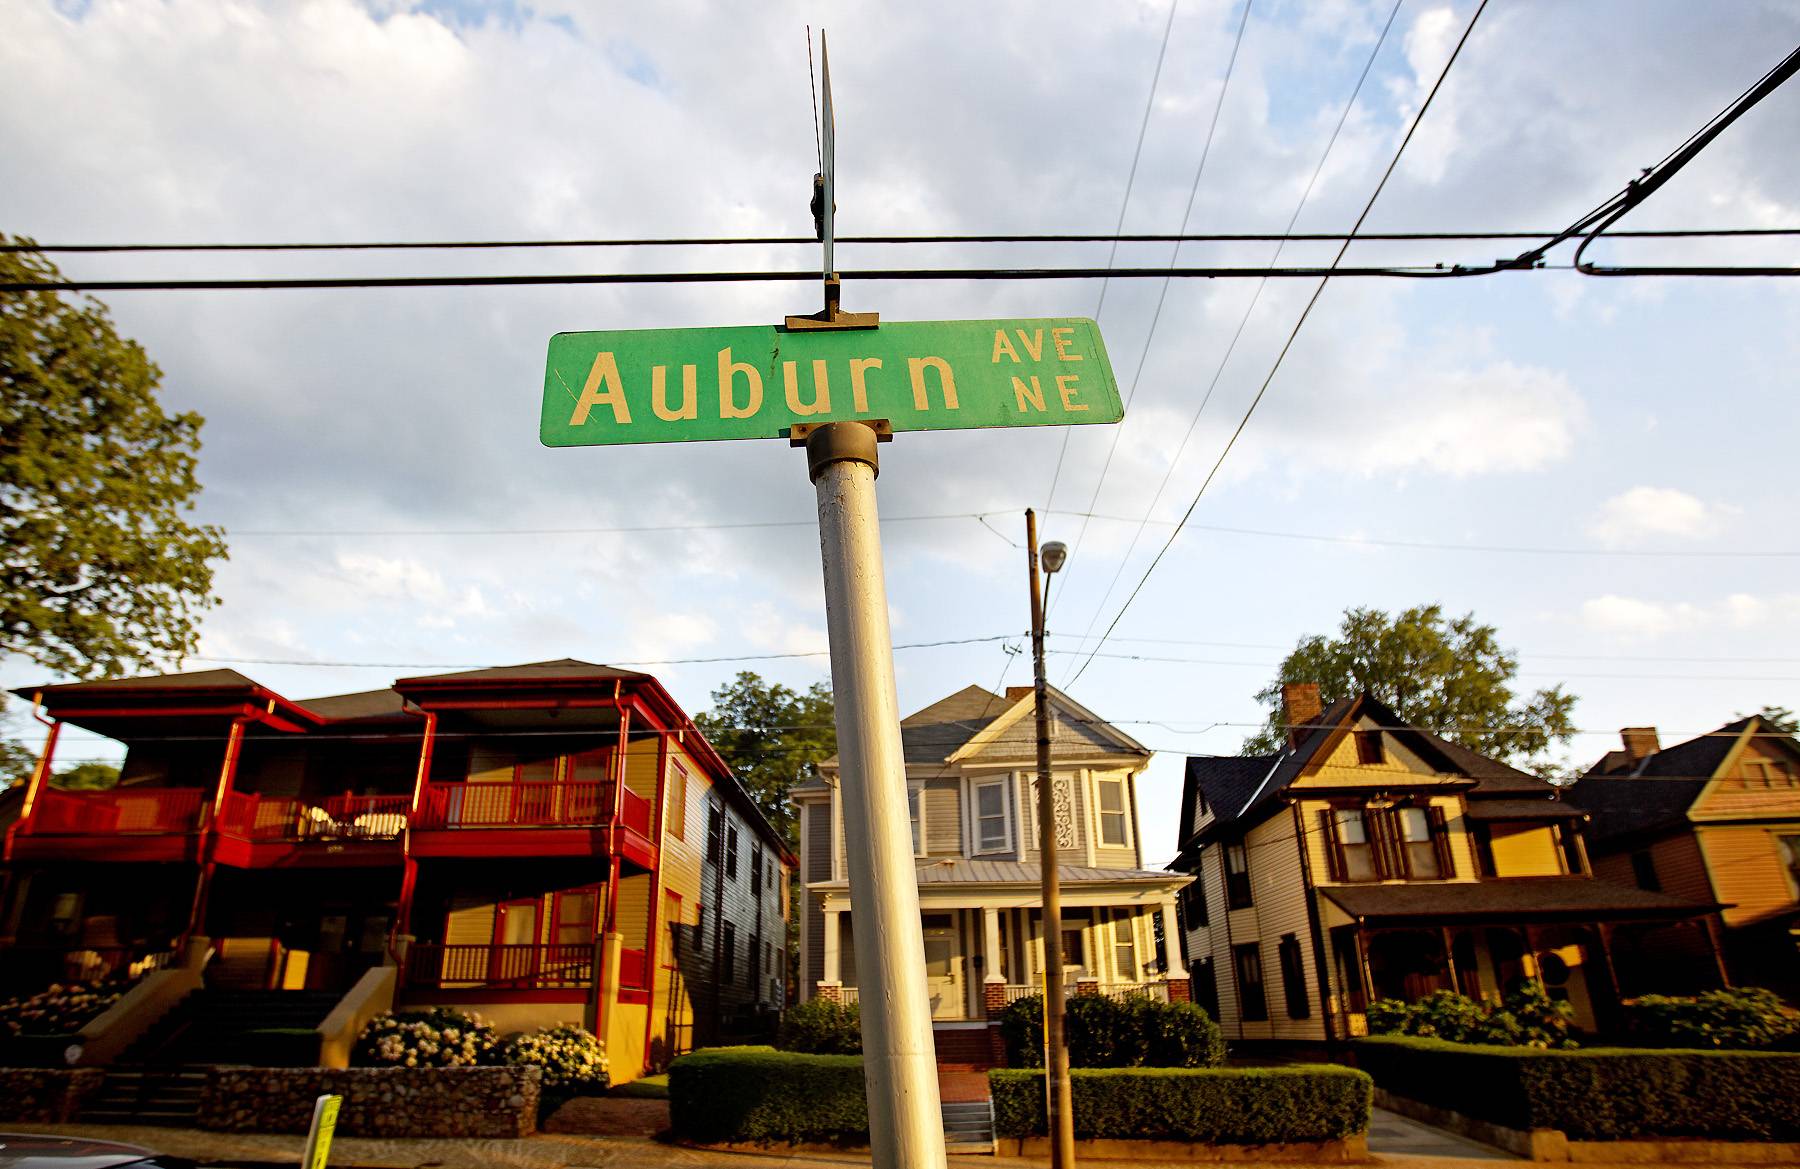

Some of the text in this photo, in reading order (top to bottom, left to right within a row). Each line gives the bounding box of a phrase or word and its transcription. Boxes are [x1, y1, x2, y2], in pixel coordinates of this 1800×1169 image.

[991, 327, 1084, 363] AVE
[569, 346, 960, 426] Auburn
[1011, 375, 1089, 412] NE
